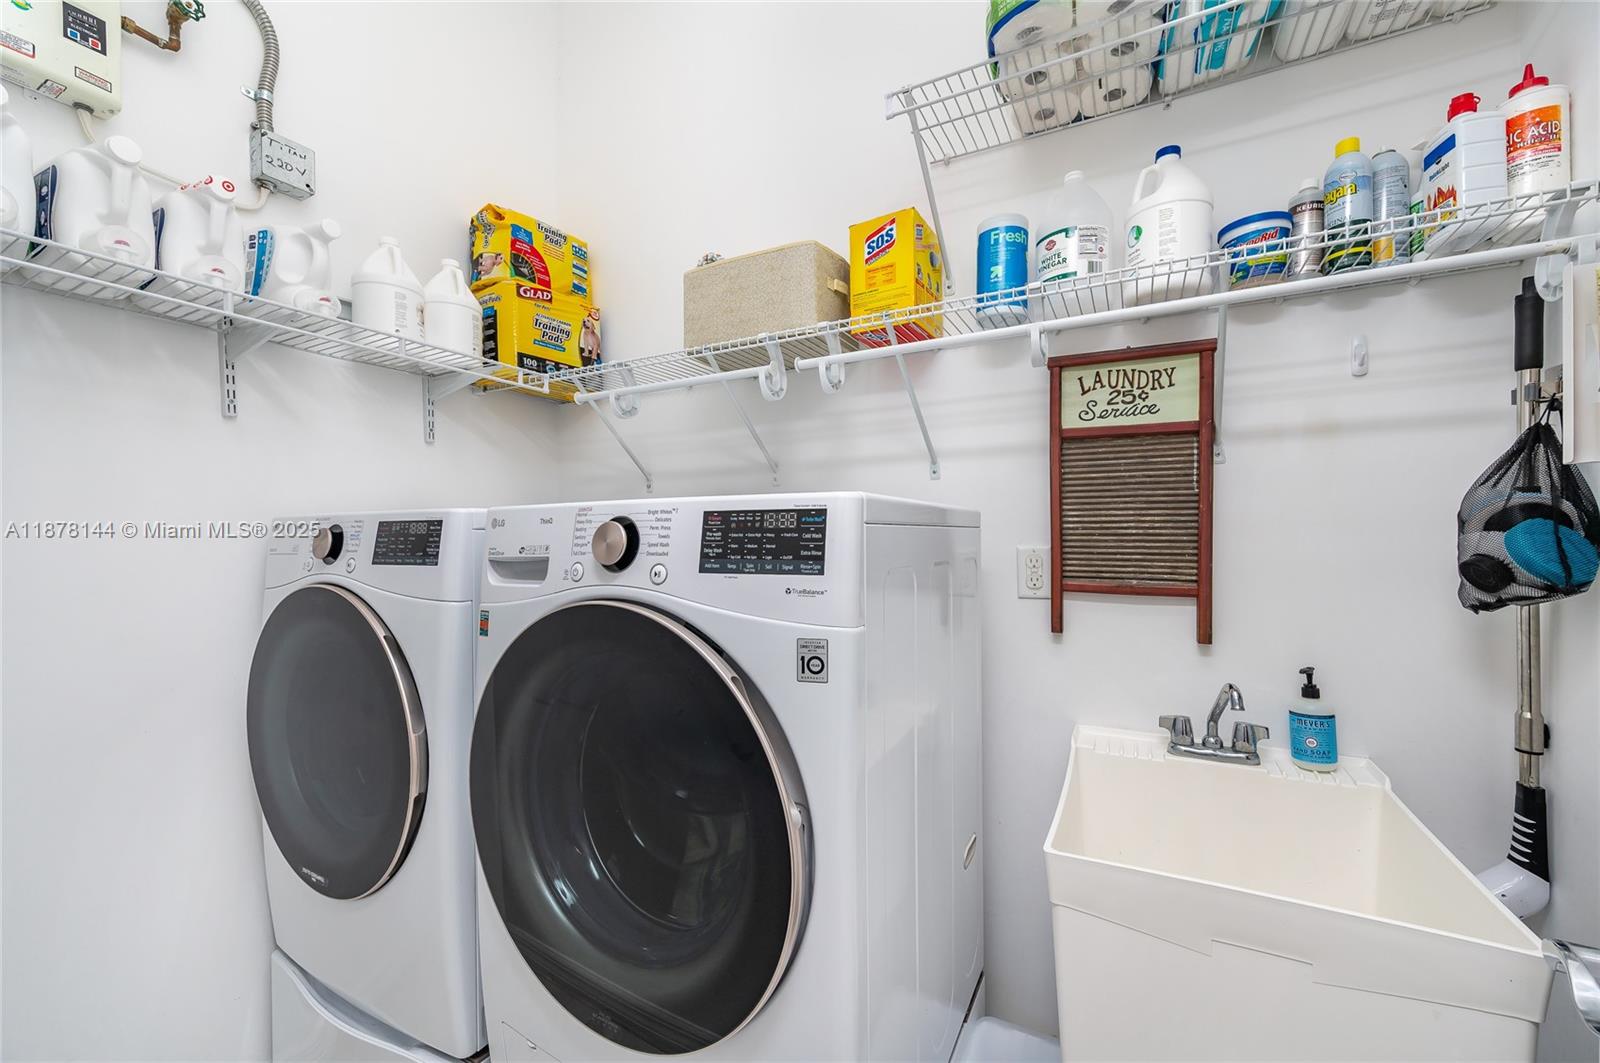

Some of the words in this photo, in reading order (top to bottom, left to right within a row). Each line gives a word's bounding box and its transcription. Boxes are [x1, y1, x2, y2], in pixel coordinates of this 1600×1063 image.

[1528, 121, 1561, 139] ACID
[536, 222, 568, 243] Training
[544, 234, 563, 247] Pads
[990, 230, 1027, 245] Fresh
[867, 227, 894, 256] SOS
[1038, 257, 1067, 273] VINEGAR
[1041, 252, 1062, 265] WHITE
[519, 286, 552, 300] GLAD
[534, 318, 571, 339] Training
[542, 331, 564, 344] Pads
[523, 357, 538, 367] 100
[1077, 366, 1177, 396] LAUNDRY
[1106, 389, 1149, 406] 25¢
[1078, 400, 1161, 422] Service
[540, 517, 553, 525] ThinQ
[800, 655, 825, 675] 10
[1310, 749, 1331, 757] SOAP
